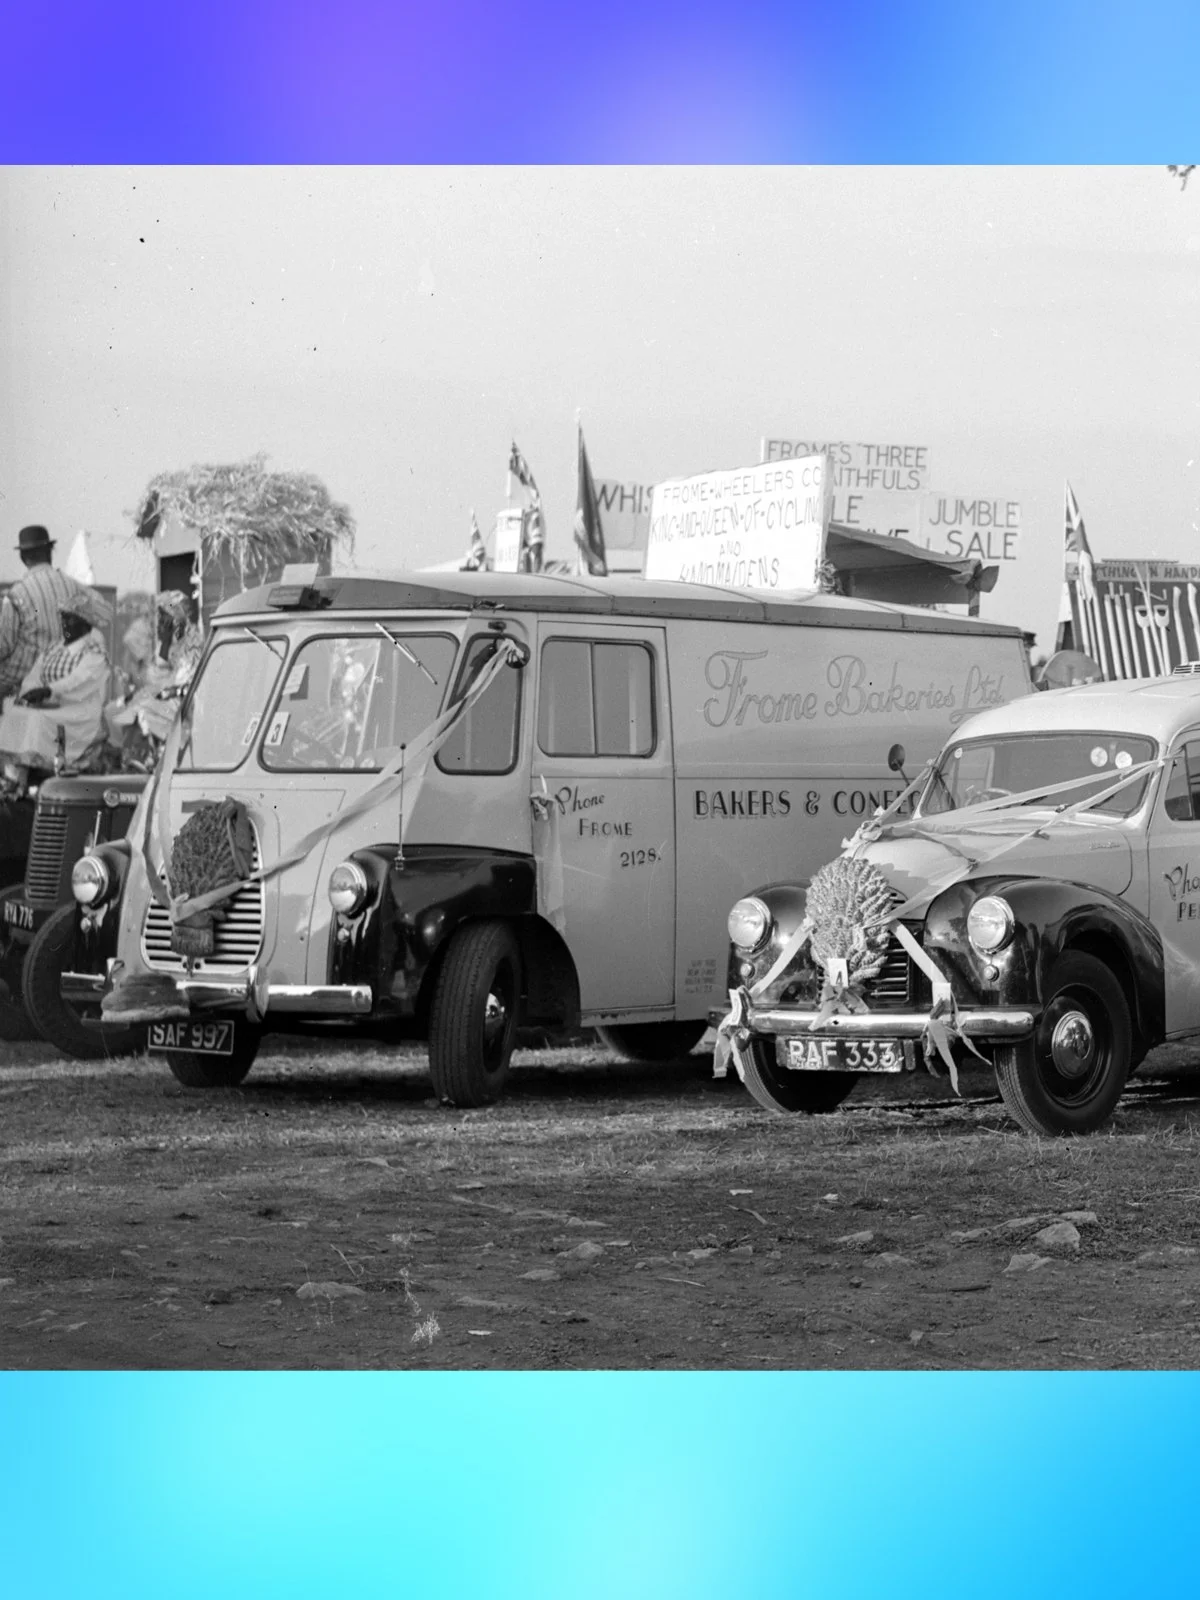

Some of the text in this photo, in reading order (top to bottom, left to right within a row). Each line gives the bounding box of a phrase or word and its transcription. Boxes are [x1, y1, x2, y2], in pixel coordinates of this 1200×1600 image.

[663, 482, 709, 505] FROME
[715, 470, 794, 499] WHEELERS
[650, 496, 821, 544] KING AND QUEEN OF CYCLIN
[929, 499, 1019, 529] JUMBLE
[719, 539, 743, 558] AND
[945, 529, 1018, 560] SALE
[704, 650, 817, 727] Frome
[824, 655, 956, 717] Bakeries
[554, 786, 605, 815] Phone
[694, 790, 791, 818] BAKERS
[806, 791, 821, 817] &
[579, 818, 633, 837] FROME
[153, 1022, 229, 1051] SAF 997
[789, 1040, 837, 1067] RAF
